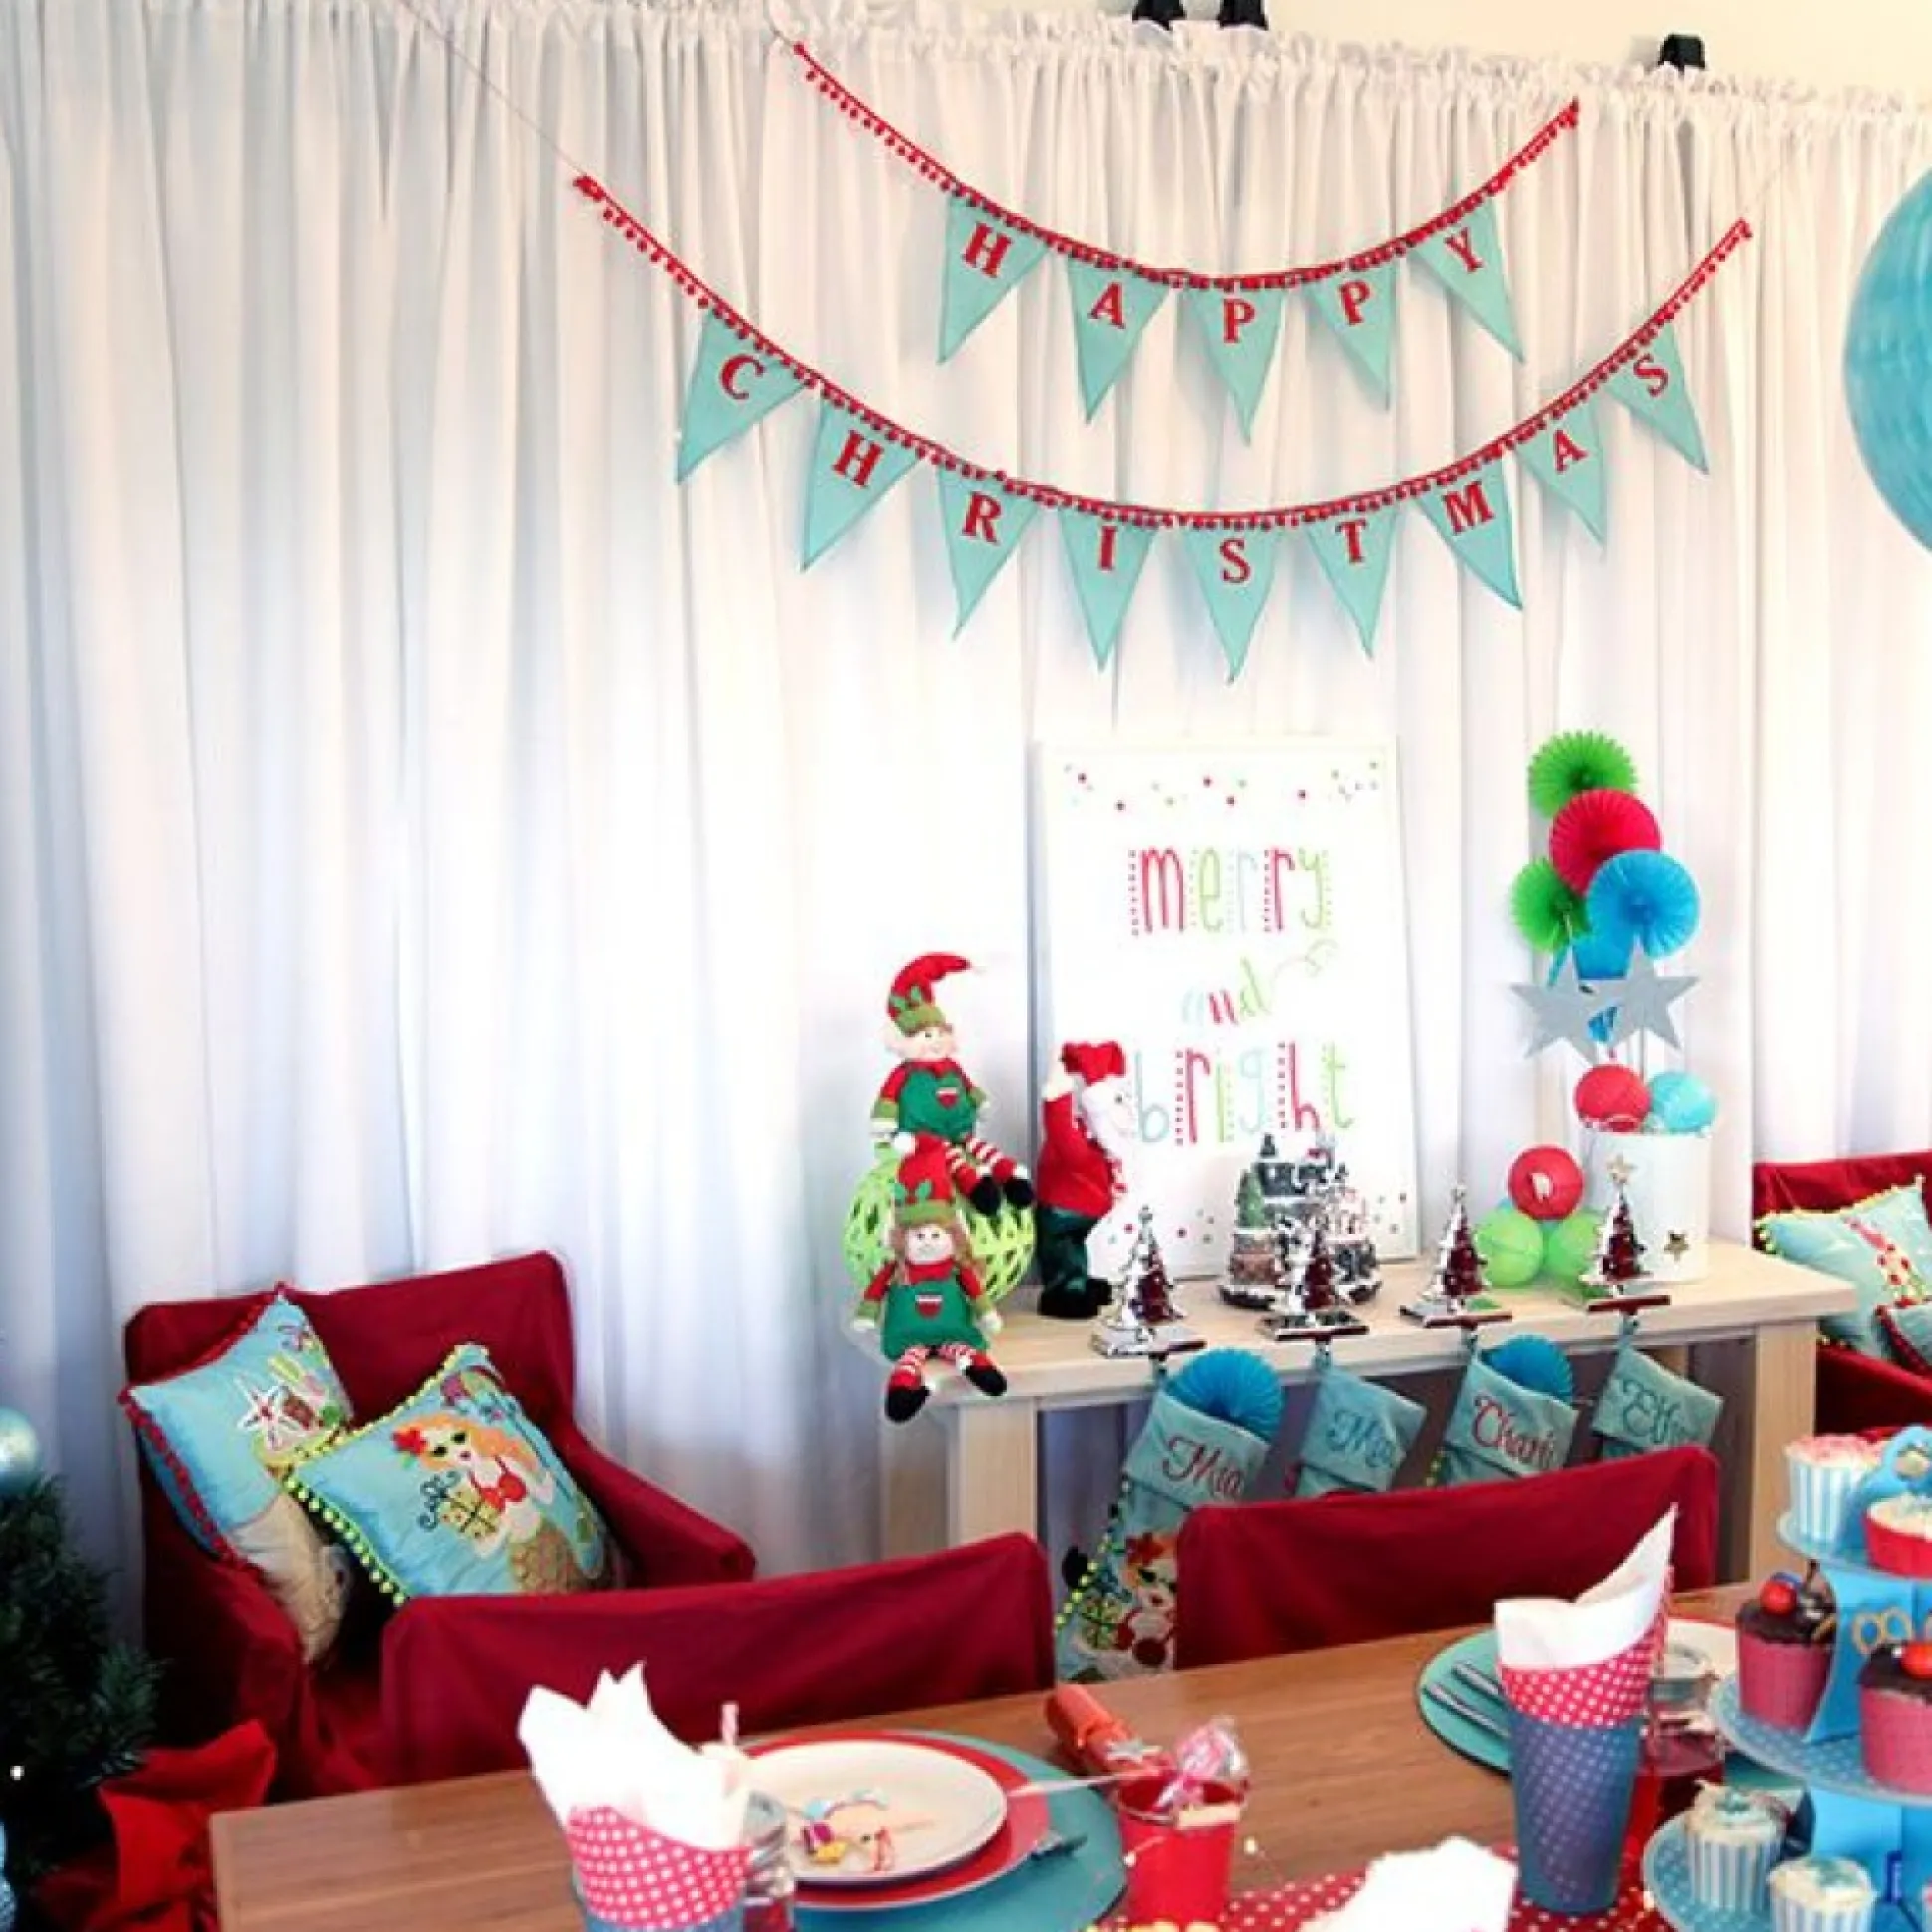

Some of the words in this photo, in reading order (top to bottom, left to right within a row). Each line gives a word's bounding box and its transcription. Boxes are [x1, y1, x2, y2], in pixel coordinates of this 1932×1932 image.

[962, 221, 1483, 343] HAPPY
[719, 353, 1669, 585] CHRISTMAS
[1129, 847, 1333, 935] merry
[1182, 954, 1279, 1026] and
[1134, 1040, 1355, 1146] bright
